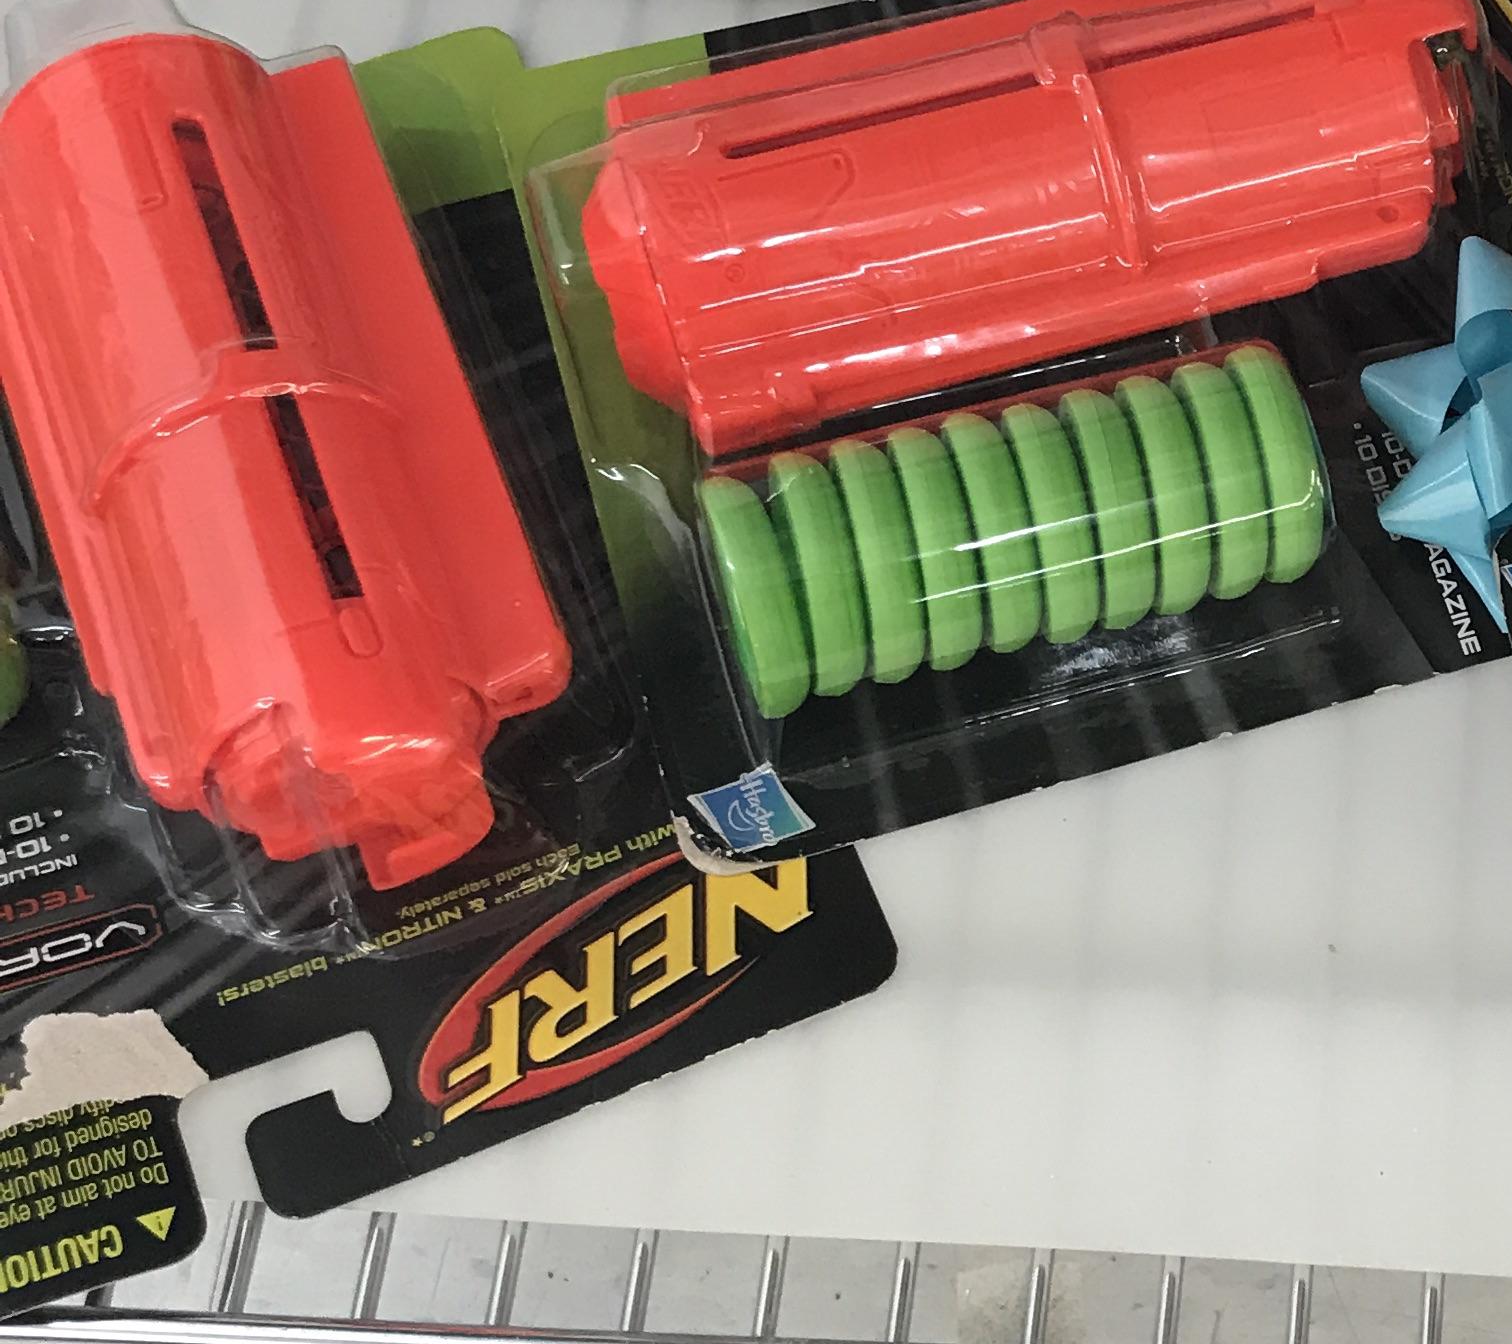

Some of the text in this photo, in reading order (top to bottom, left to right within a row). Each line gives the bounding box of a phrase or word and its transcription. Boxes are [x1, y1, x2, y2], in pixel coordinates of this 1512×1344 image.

[1353, 434, 1378, 463] 10
[7, 810, 45, 835] 10
[738, 769, 781, 850] Hasbro
[625, 821, 677, 855] with
[394, 841, 582, 921] Each sold separately.
[467, 894, 487, 914] &
[211, 953, 328, 1009] blasters!
[442, 856, 812, 1125] NERF
[31, 1104, 154, 1162] designed for
[64, 1134, 162, 1181] TO AVOID
[33, 1160, 169, 1220] Do not aim at
